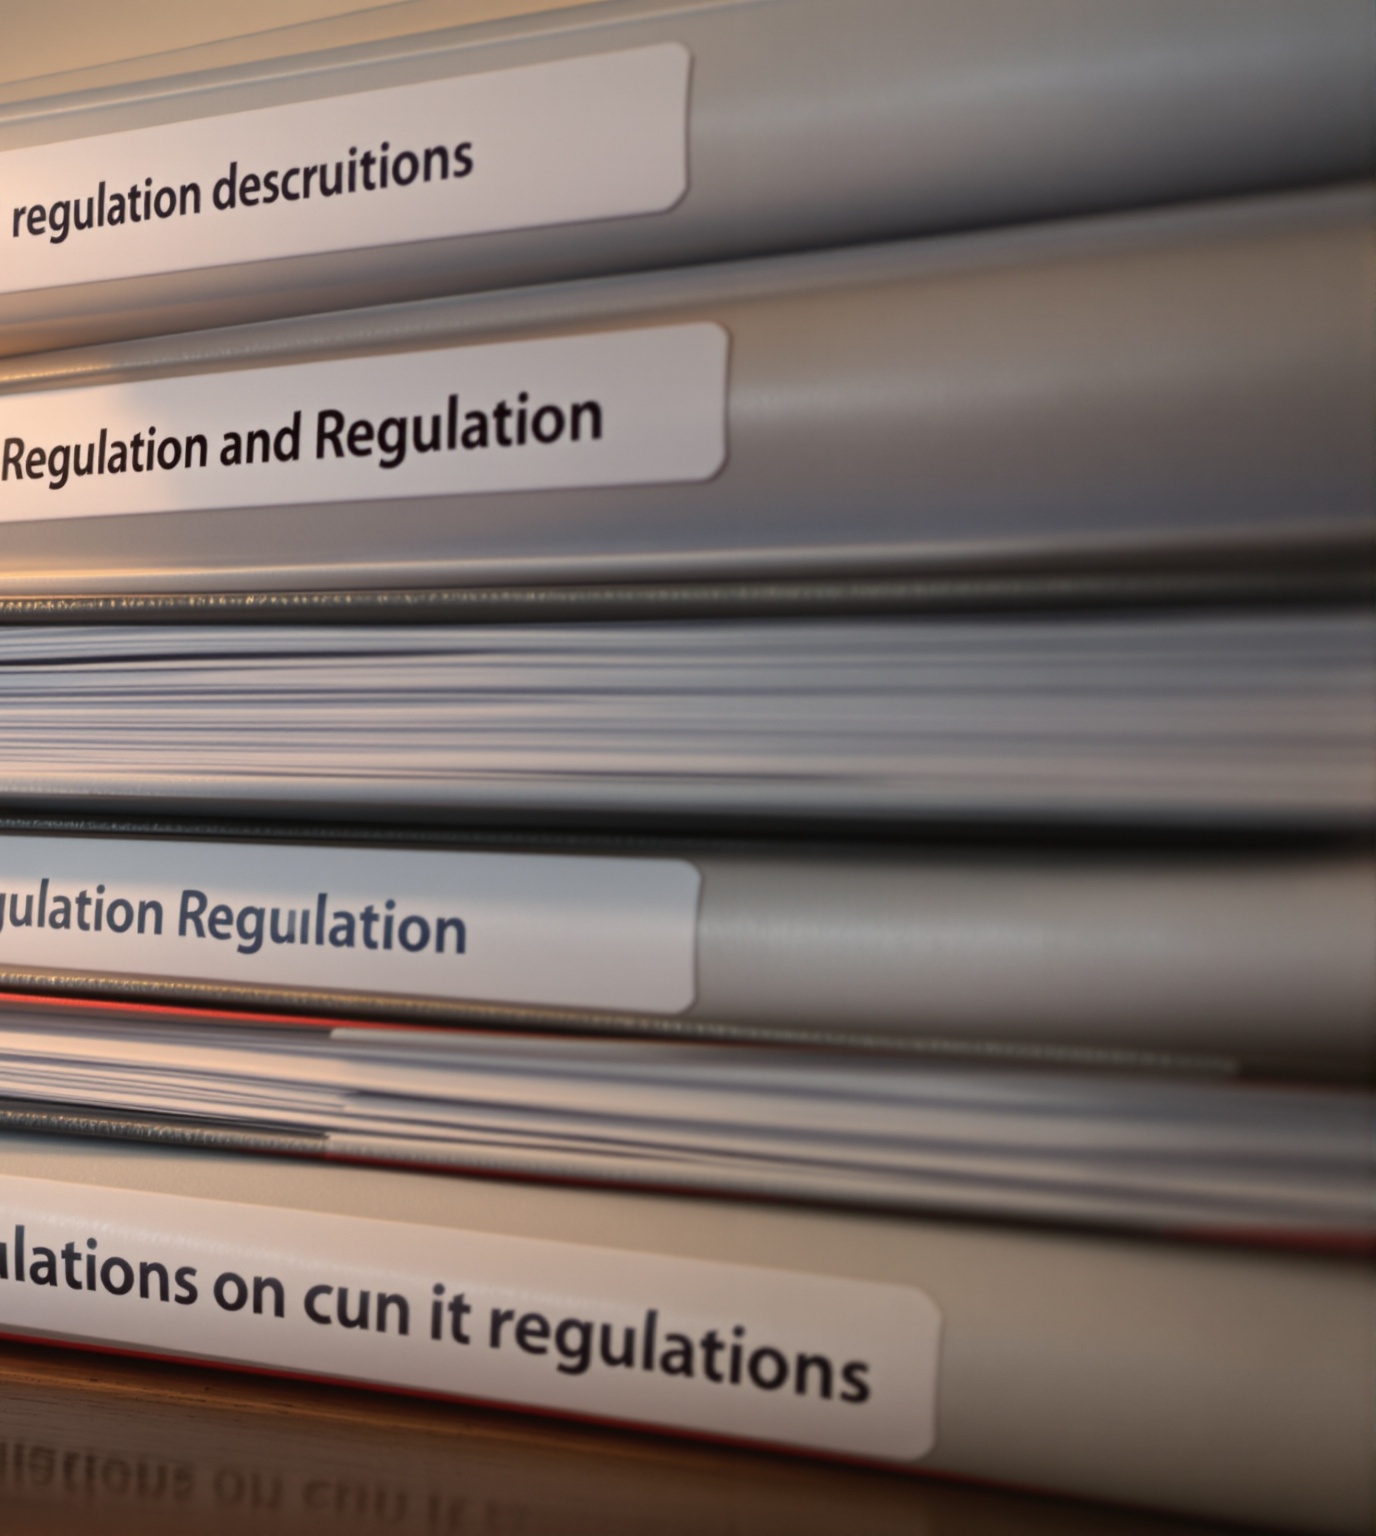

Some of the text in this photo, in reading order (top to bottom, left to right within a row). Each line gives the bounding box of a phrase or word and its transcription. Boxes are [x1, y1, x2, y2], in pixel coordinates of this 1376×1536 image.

[12, 176, 202, 245] regulation
[211, 140, 475, 212] descruitions
[0, 425, 209, 491] Regulation
[219, 409, 303, 467] and
[315, 390, 603, 471] Regulation
[212, 1271, 286, 1319] on
[303, 1283, 411, 1337] cun
[430, 1282, 472, 1346] it
[488, 1307, 872, 1405] regulations
